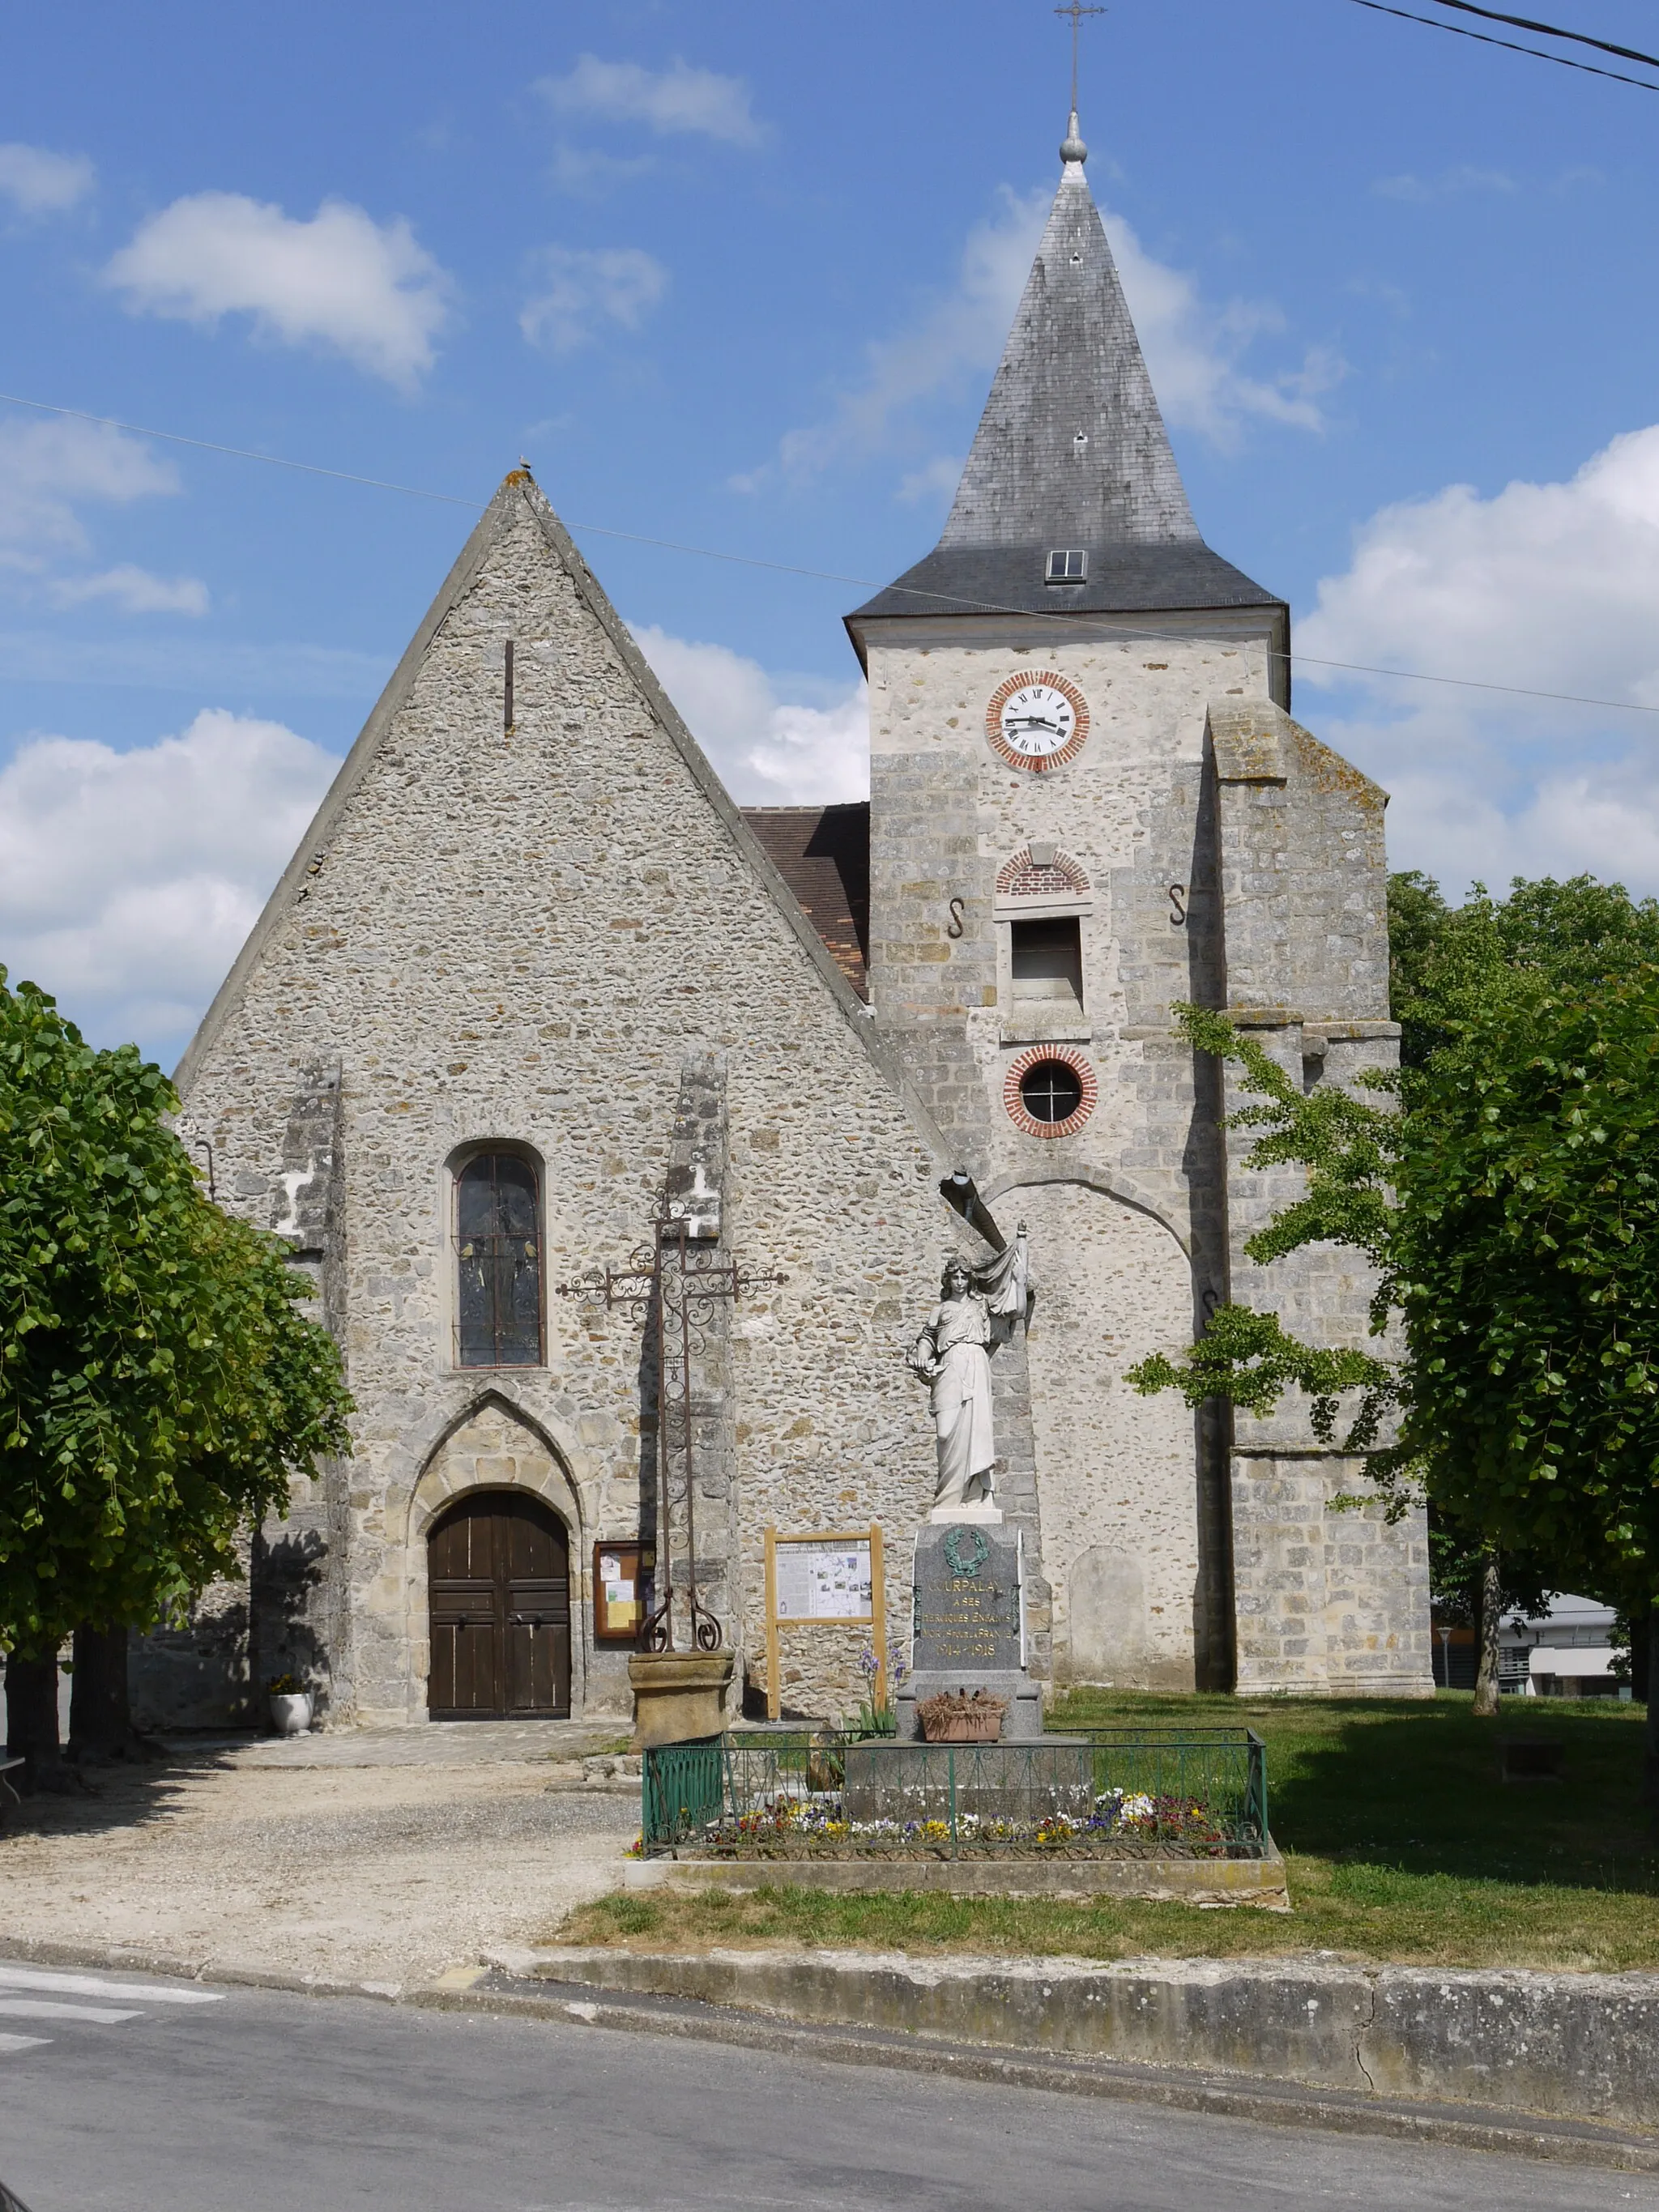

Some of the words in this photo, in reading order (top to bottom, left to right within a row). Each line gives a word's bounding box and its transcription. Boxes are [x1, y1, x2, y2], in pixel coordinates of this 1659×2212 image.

[1018, 693, 1028, 705] XI
[1032, 689, 1043, 699] XII
[1008, 729, 1019, 742] VIII
[1019, 739, 1029, 751] VII
[1034, 743, 1041, 752] VI
[962, 1597, 981, 1606] SES
[978, 1628, 1012, 1639] FRANE
